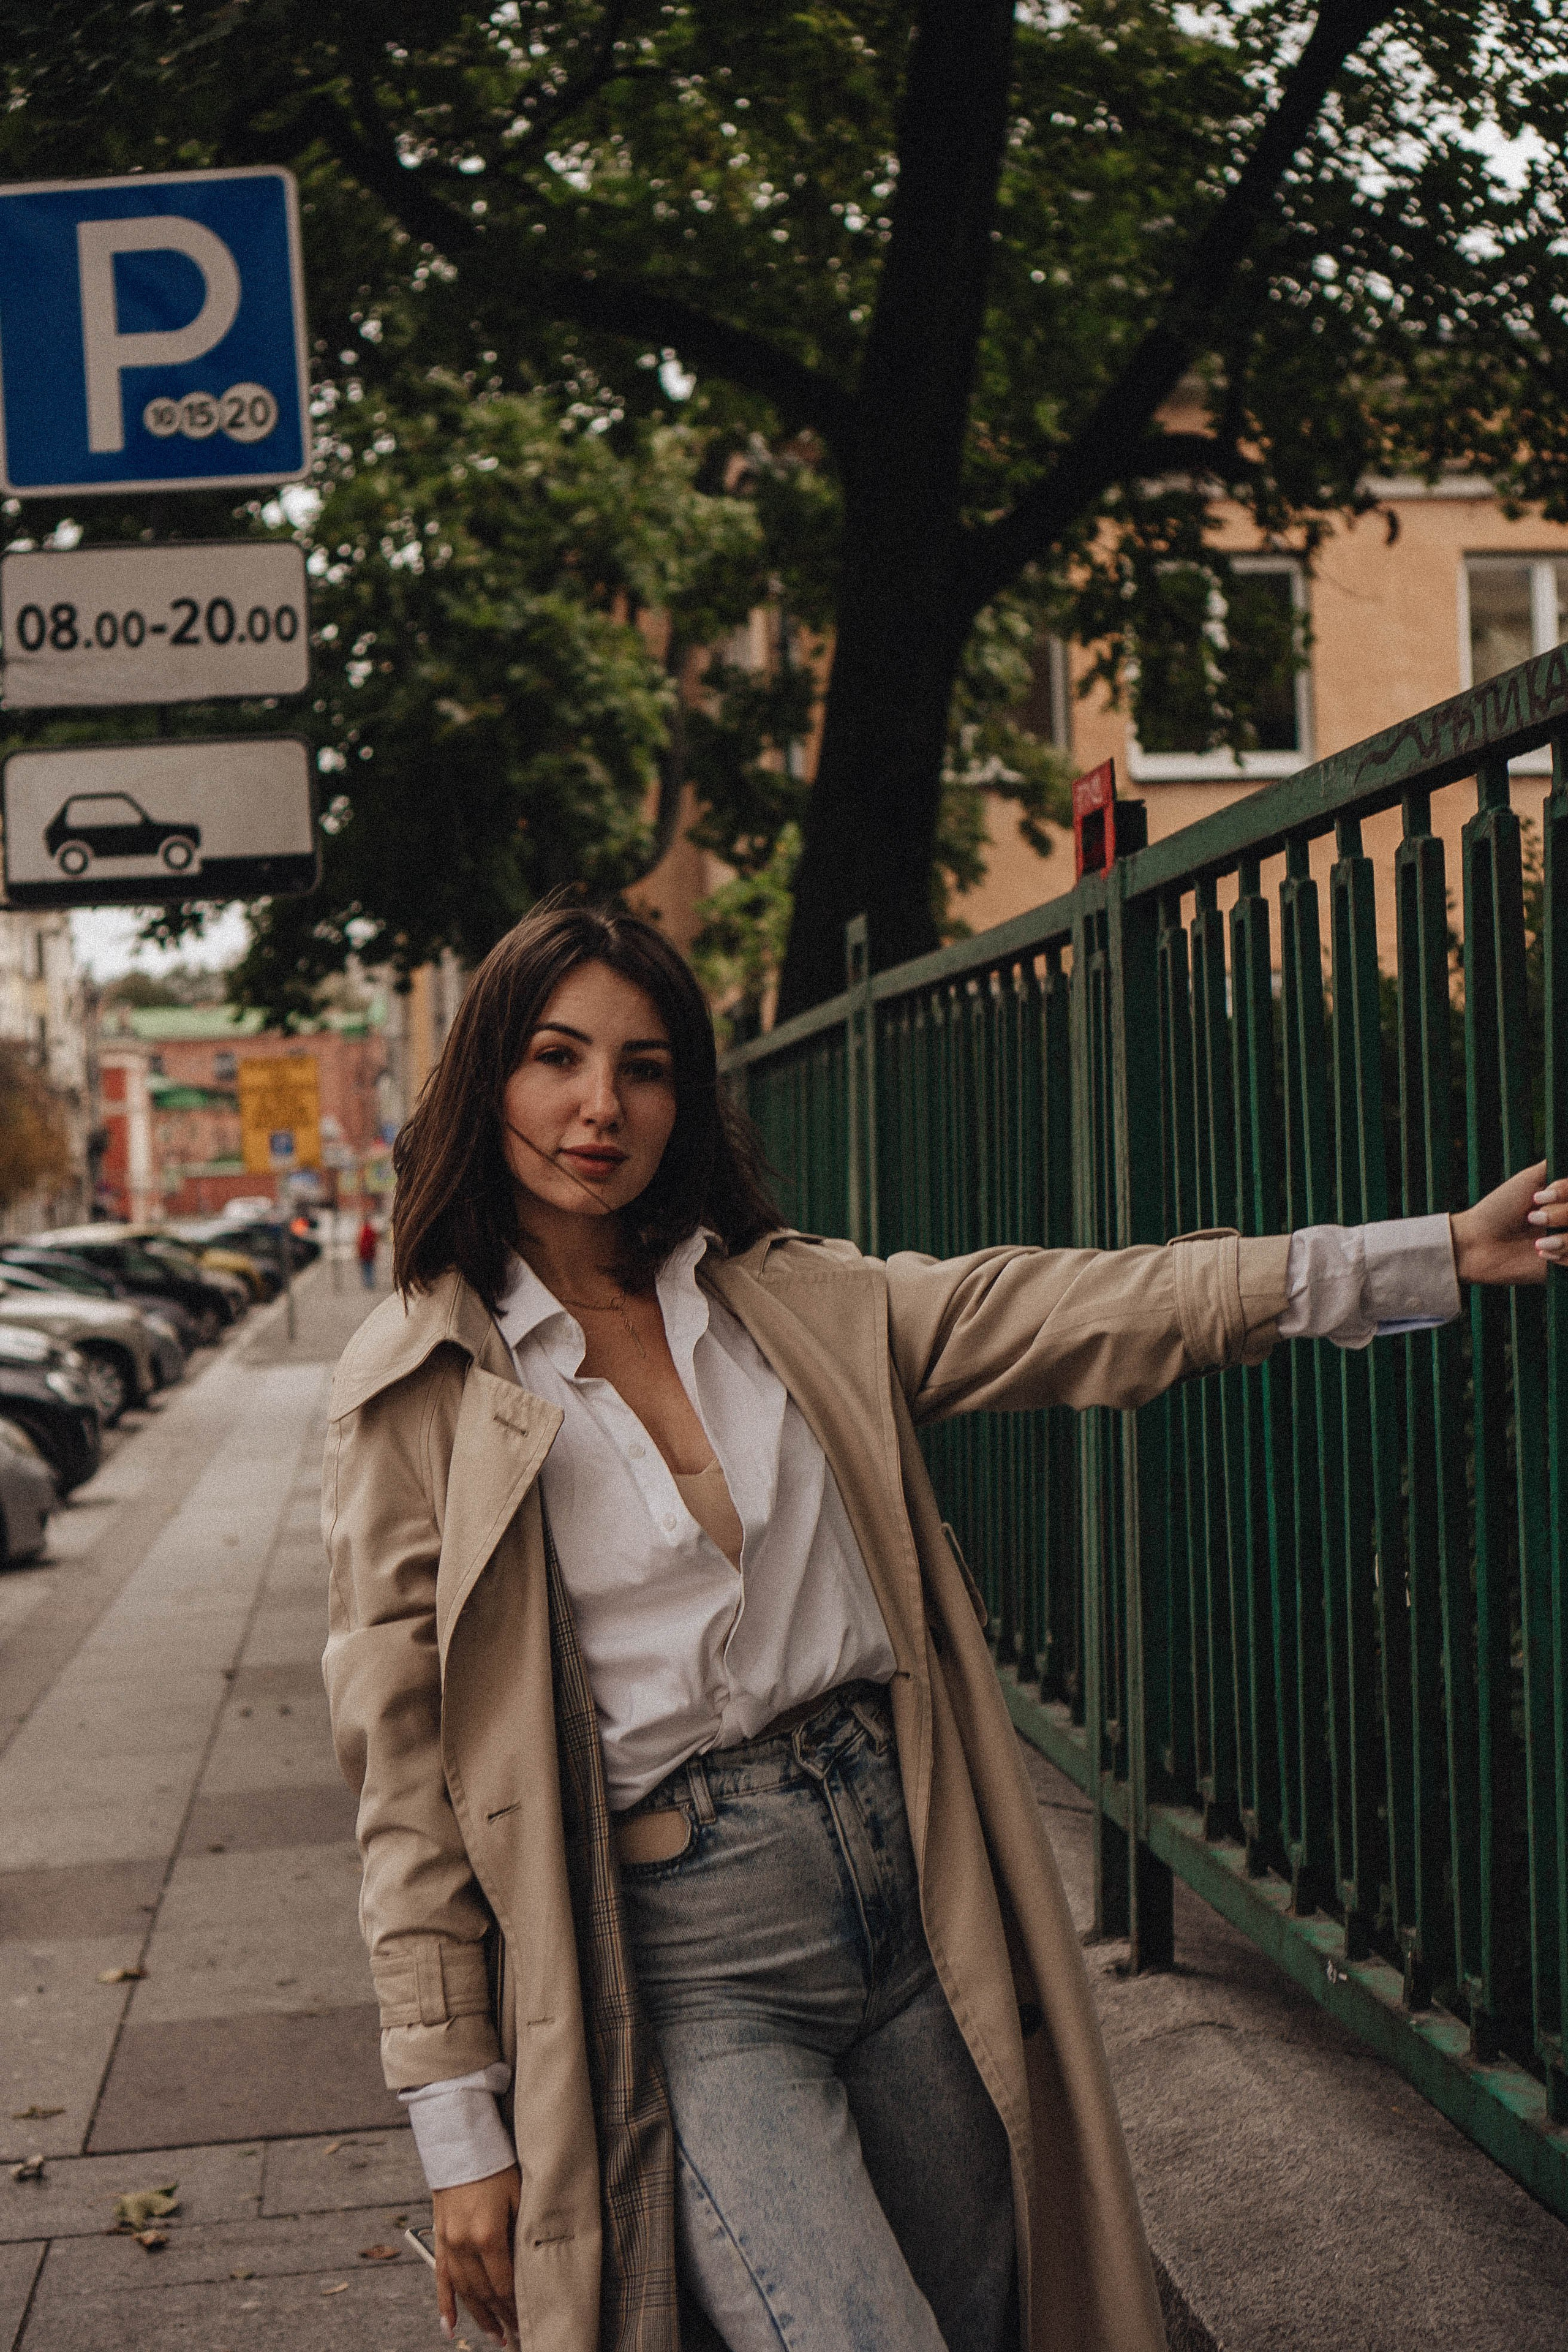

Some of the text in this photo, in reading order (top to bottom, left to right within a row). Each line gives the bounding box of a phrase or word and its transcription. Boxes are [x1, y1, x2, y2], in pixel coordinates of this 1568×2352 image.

[77, 214, 243, 453] P
[152, 395, 271, 429] 10 15 20
[16, 596, 299, 652] 08.00-20.00
